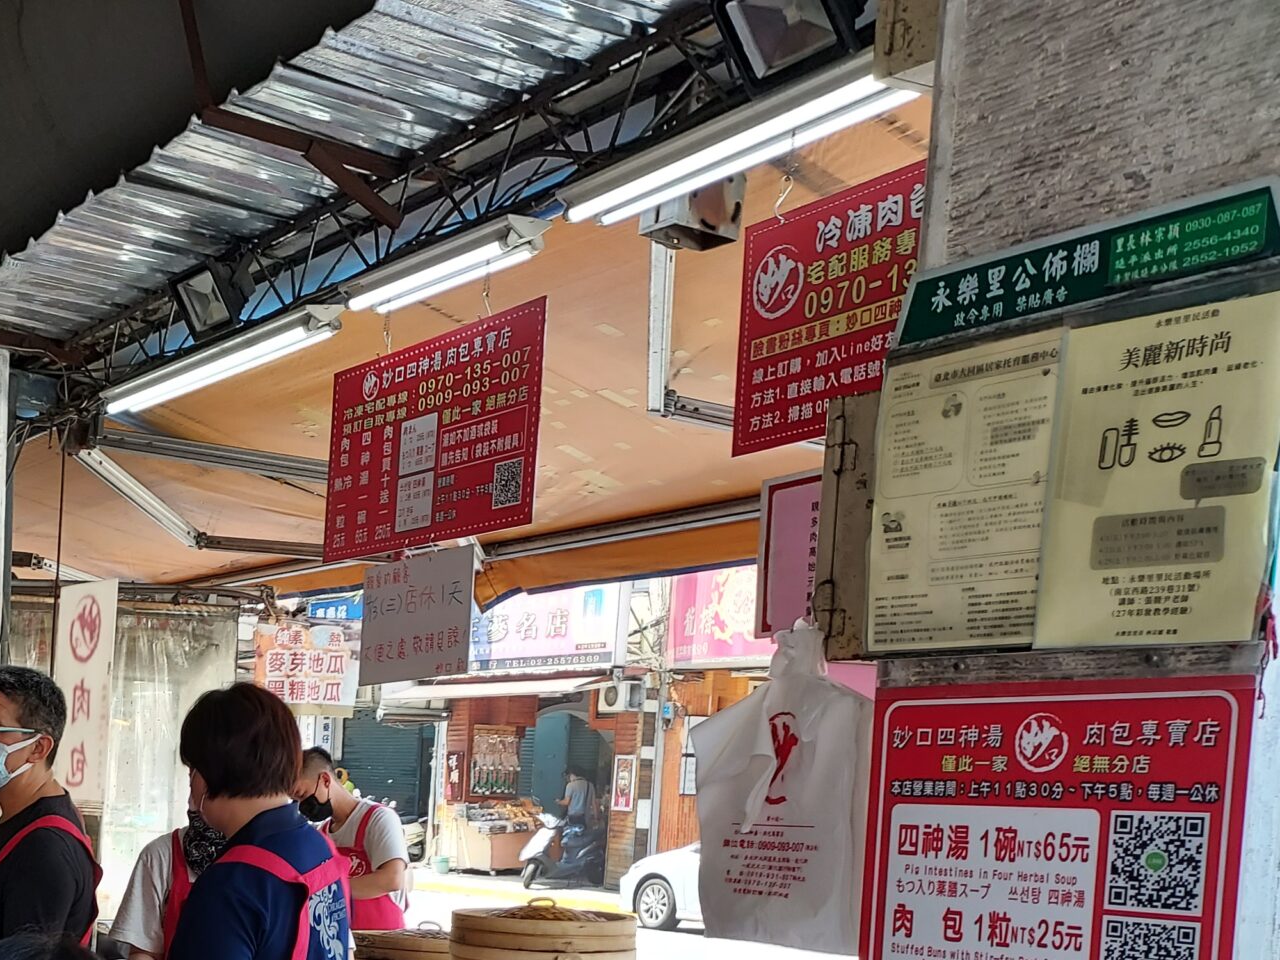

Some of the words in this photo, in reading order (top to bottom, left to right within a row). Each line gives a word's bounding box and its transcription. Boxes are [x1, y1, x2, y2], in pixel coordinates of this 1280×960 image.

[1185, 203, 1263, 232] 0930-087-087
[1183, 224, 1259, 252] 2556-4340
[931, 240, 1100, 313] 永樂里公佈欄
[1119, 331, 1232, 371] 美麗新時尚
[268, 651, 344, 674] 麥芽地瓜
[892, 724, 1004, 749] 妙口四神湯
[1083, 718, 1221, 748] 肉包專賣店
[941, 755, 1008, 773] 僅此一家
[1073, 755, 1151, 774] 絕無分店
[898, 823, 970, 861] 四神湯
[904, 863, 920, 877] Pig
[924, 864, 975, 879] Intestines
[979, 868, 988, 880] in
[992, 869, 1014, 881] Four
[1017, 871, 1050, 884] Herbal
[1055, 873, 1078, 887] Soup
[1047, 888, 1086, 909] 四神湯
[890, 942, 924, 958] Stuffed
[927, 946, 947, 960] Buns
